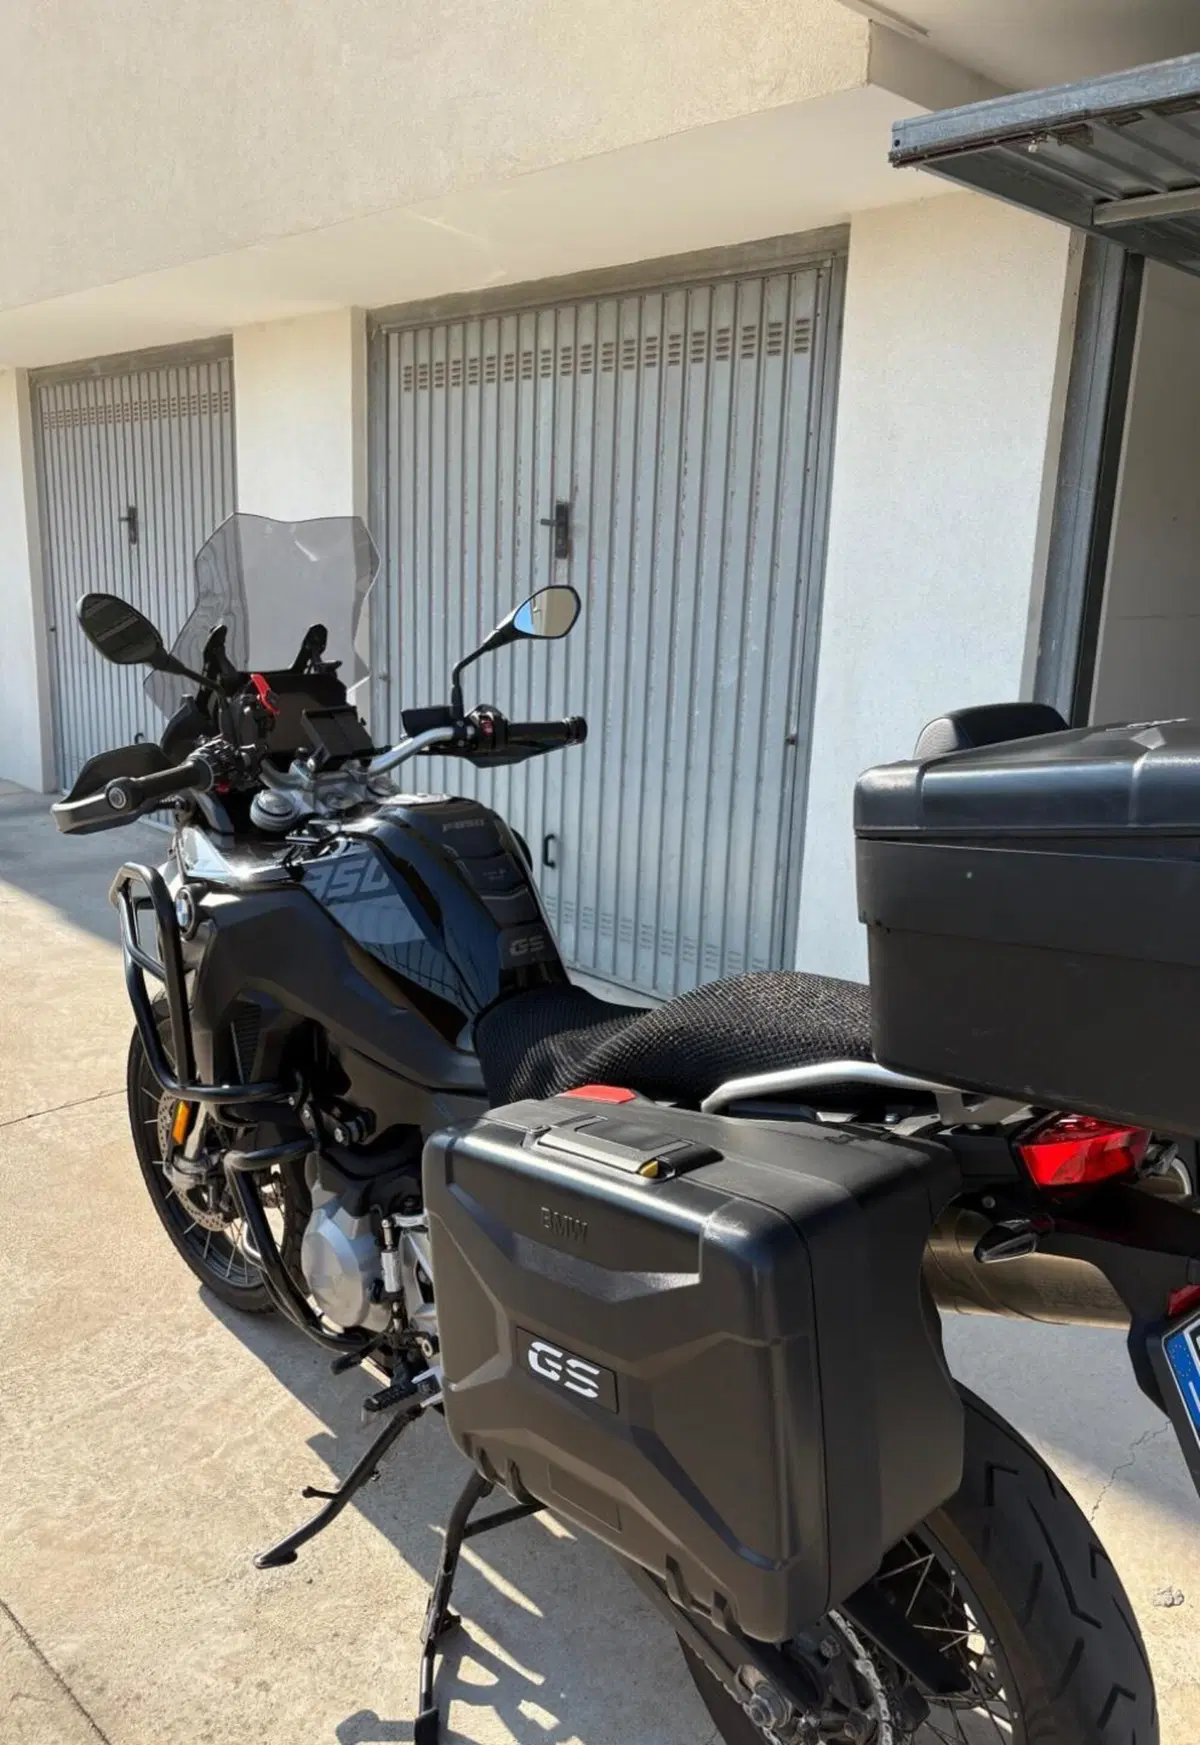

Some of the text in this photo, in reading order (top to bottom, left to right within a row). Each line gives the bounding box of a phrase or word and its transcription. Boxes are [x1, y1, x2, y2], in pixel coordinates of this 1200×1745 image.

[510, 936, 544, 956] GS
[541, 1206, 589, 1244] BMW
[528, 1341, 600, 1398] GS
